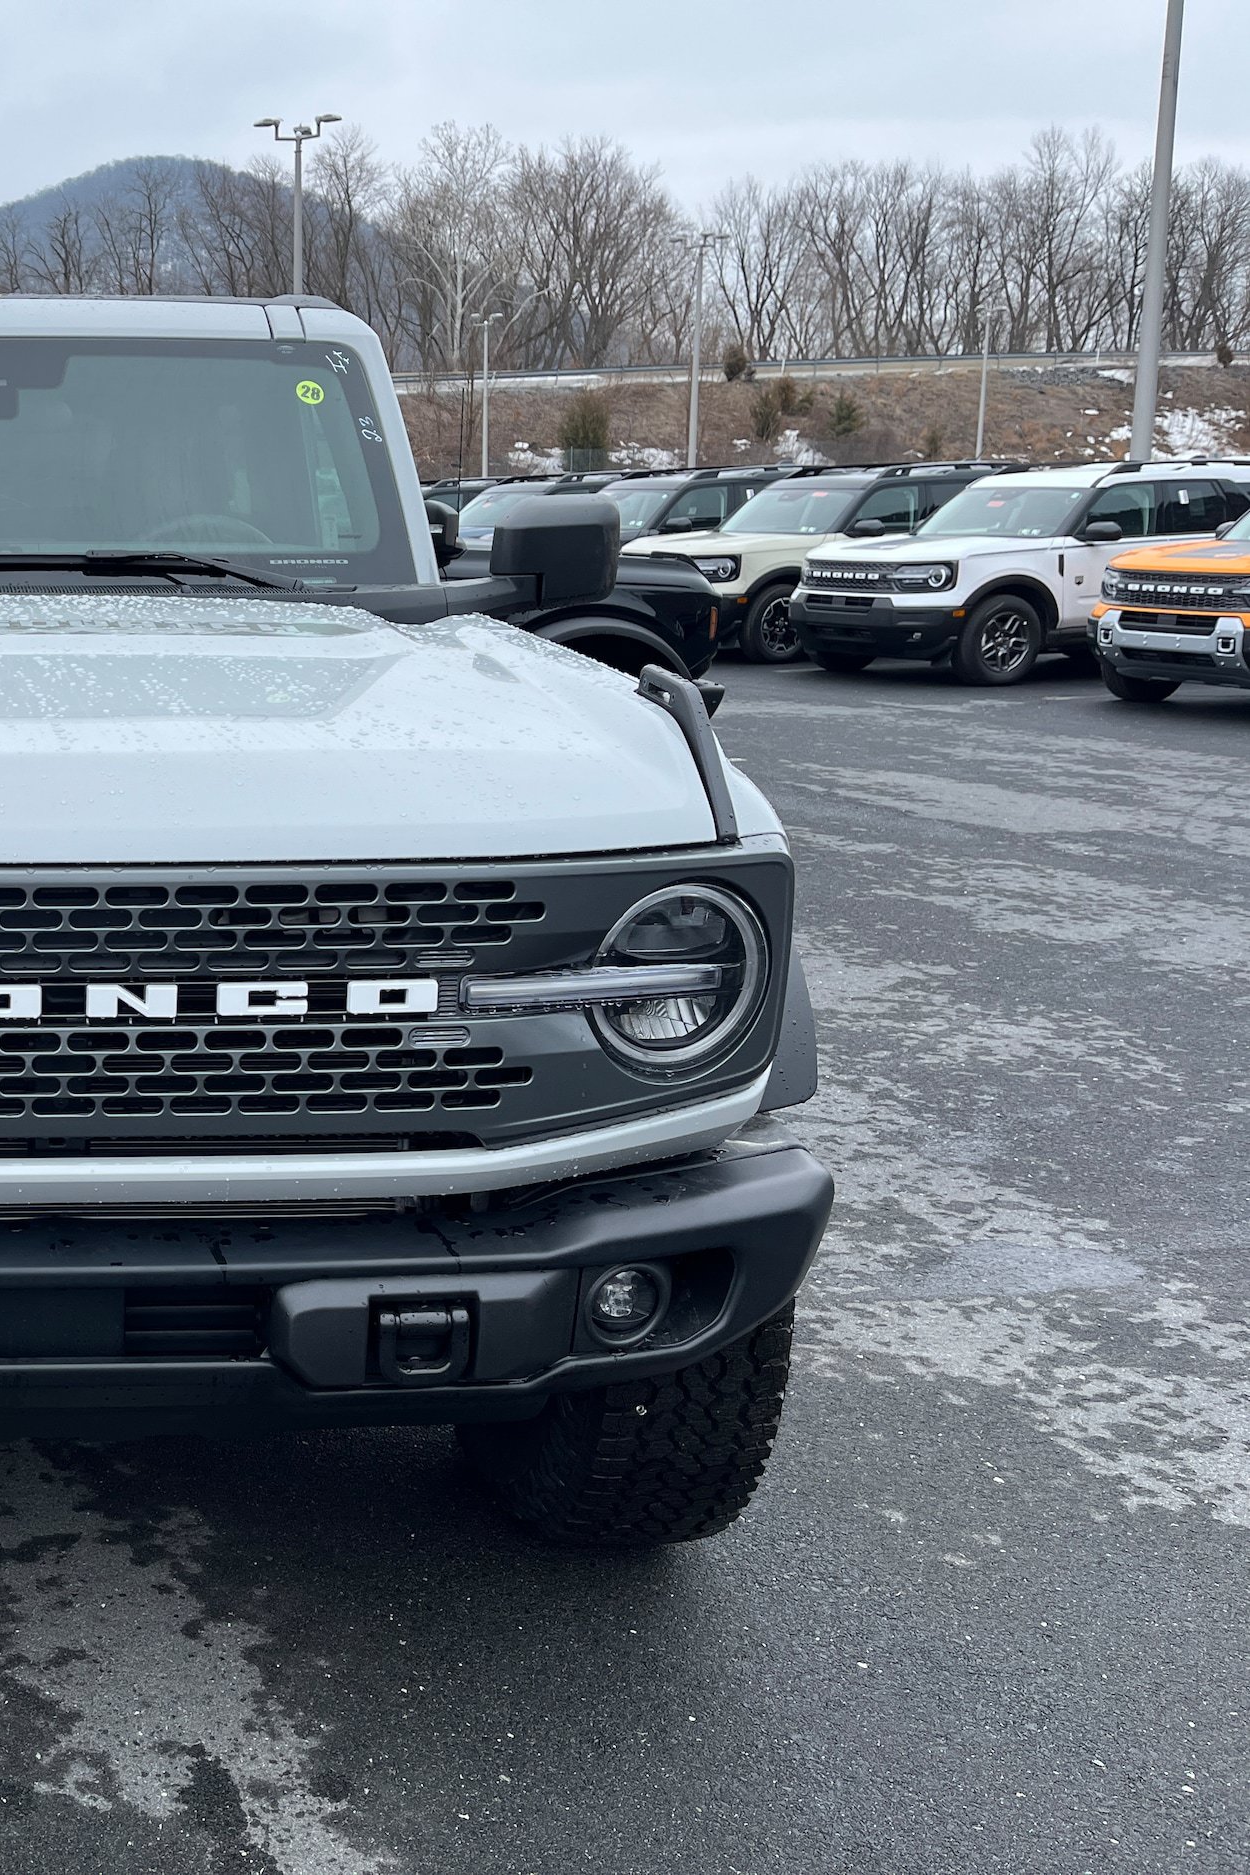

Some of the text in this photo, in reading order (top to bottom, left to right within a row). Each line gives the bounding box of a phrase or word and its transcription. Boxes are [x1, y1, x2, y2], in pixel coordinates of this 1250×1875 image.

[301, 384, 321, 400] 28
[812, 571, 880, 580] BRONCO
[1127, 583, 1223, 595] BRONCO
